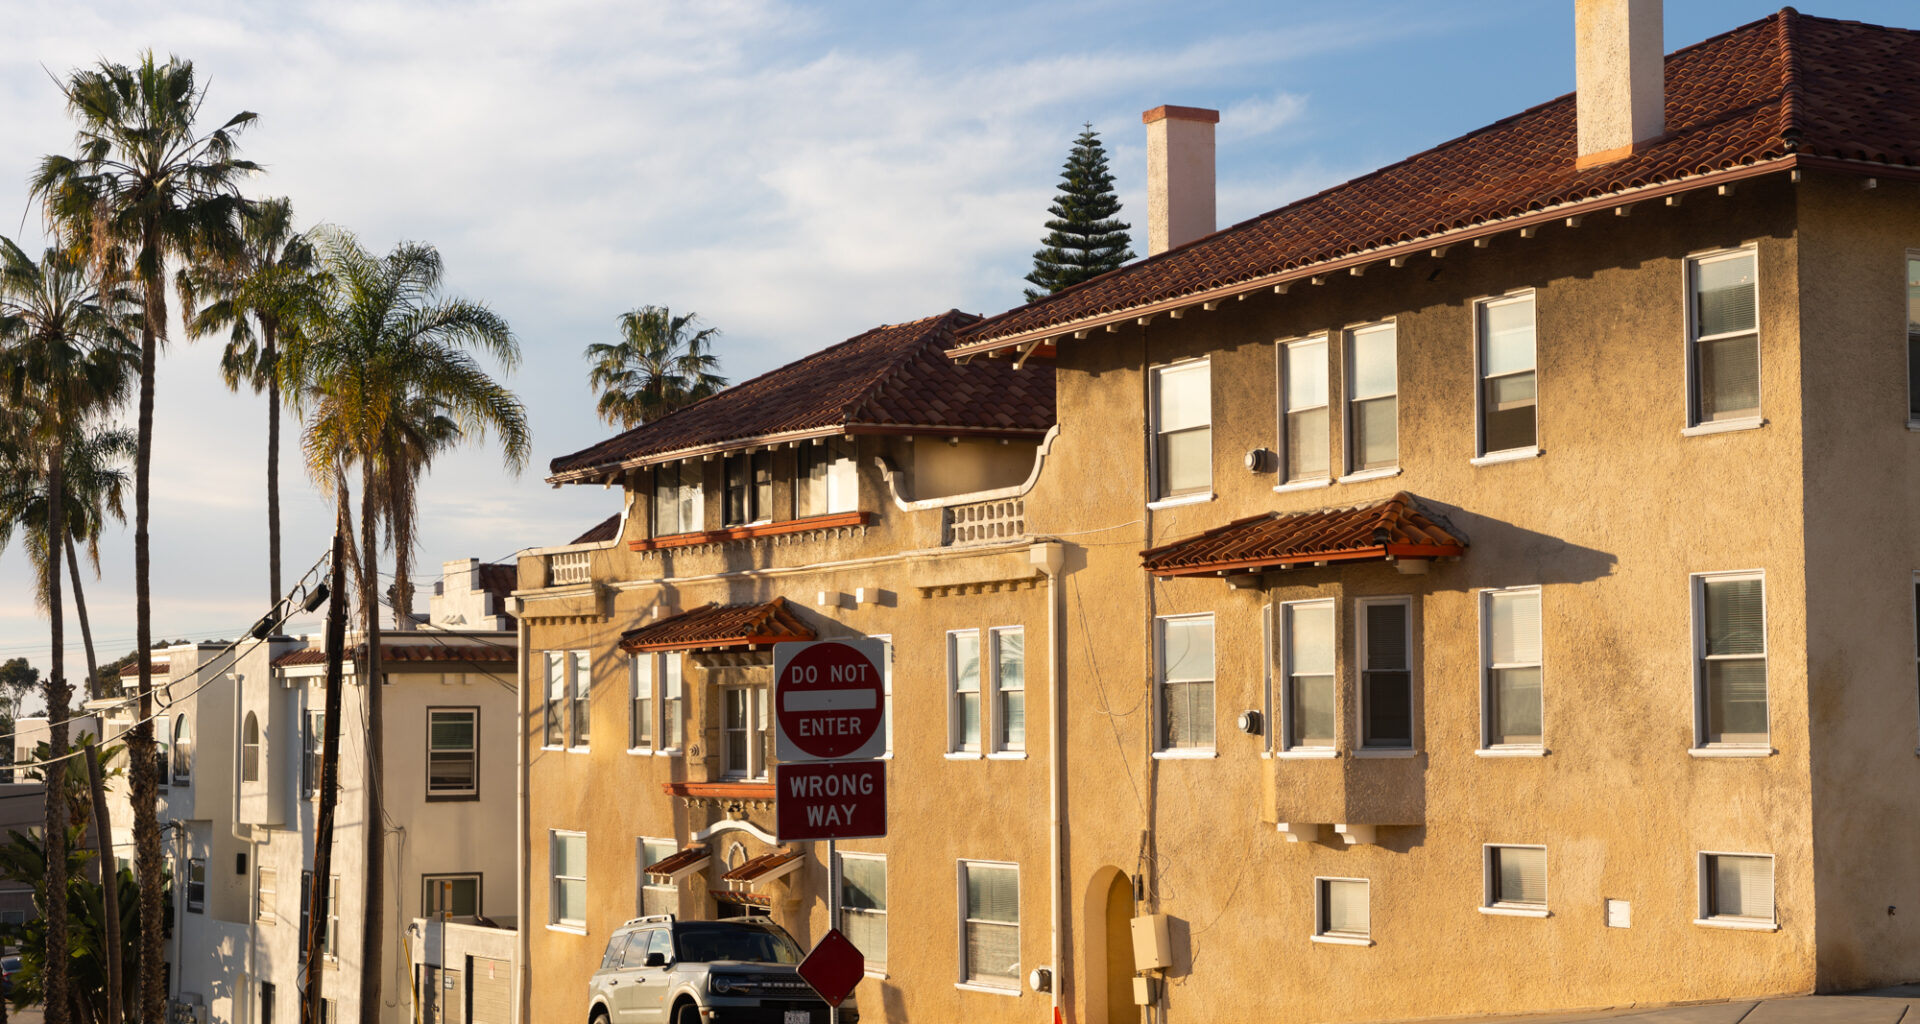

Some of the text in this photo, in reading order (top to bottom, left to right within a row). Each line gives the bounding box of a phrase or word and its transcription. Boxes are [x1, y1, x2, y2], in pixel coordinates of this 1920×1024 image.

[792, 664, 868, 684] DO NOT
[799, 717, 861, 736] ENTER
[790, 773, 873, 798] WRONG
[807, 804, 856, 827] WAY
